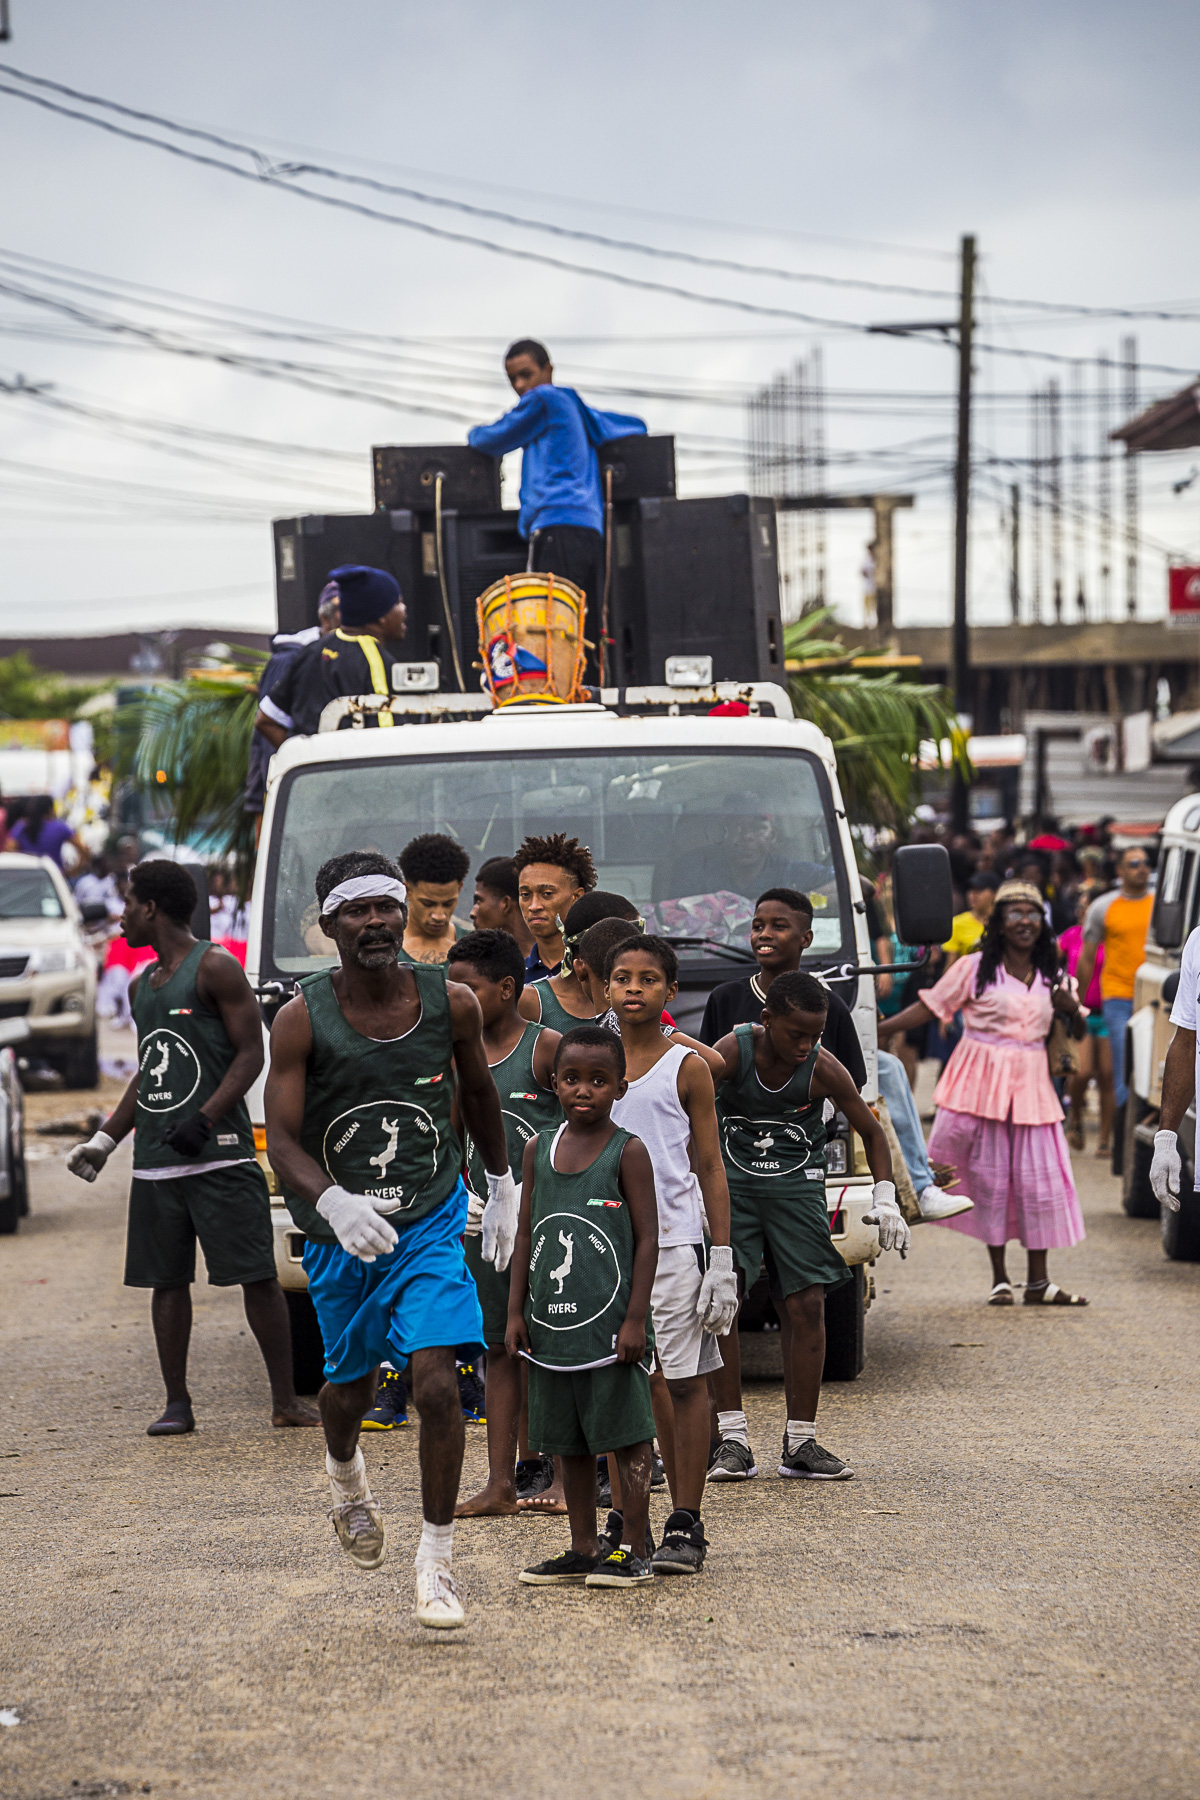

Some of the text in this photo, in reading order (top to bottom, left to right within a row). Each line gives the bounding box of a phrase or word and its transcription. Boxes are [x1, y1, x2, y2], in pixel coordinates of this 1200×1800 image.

[148, 1092, 172, 1101] FLYERS
[333, 1116, 429, 1154] BELIZEAN HIGH
[784, 1128, 800, 1141] HIGH
[529, 1233, 606, 1272] BELIZEAN HIGH
[548, 1303, 577, 1314] FLYERS
